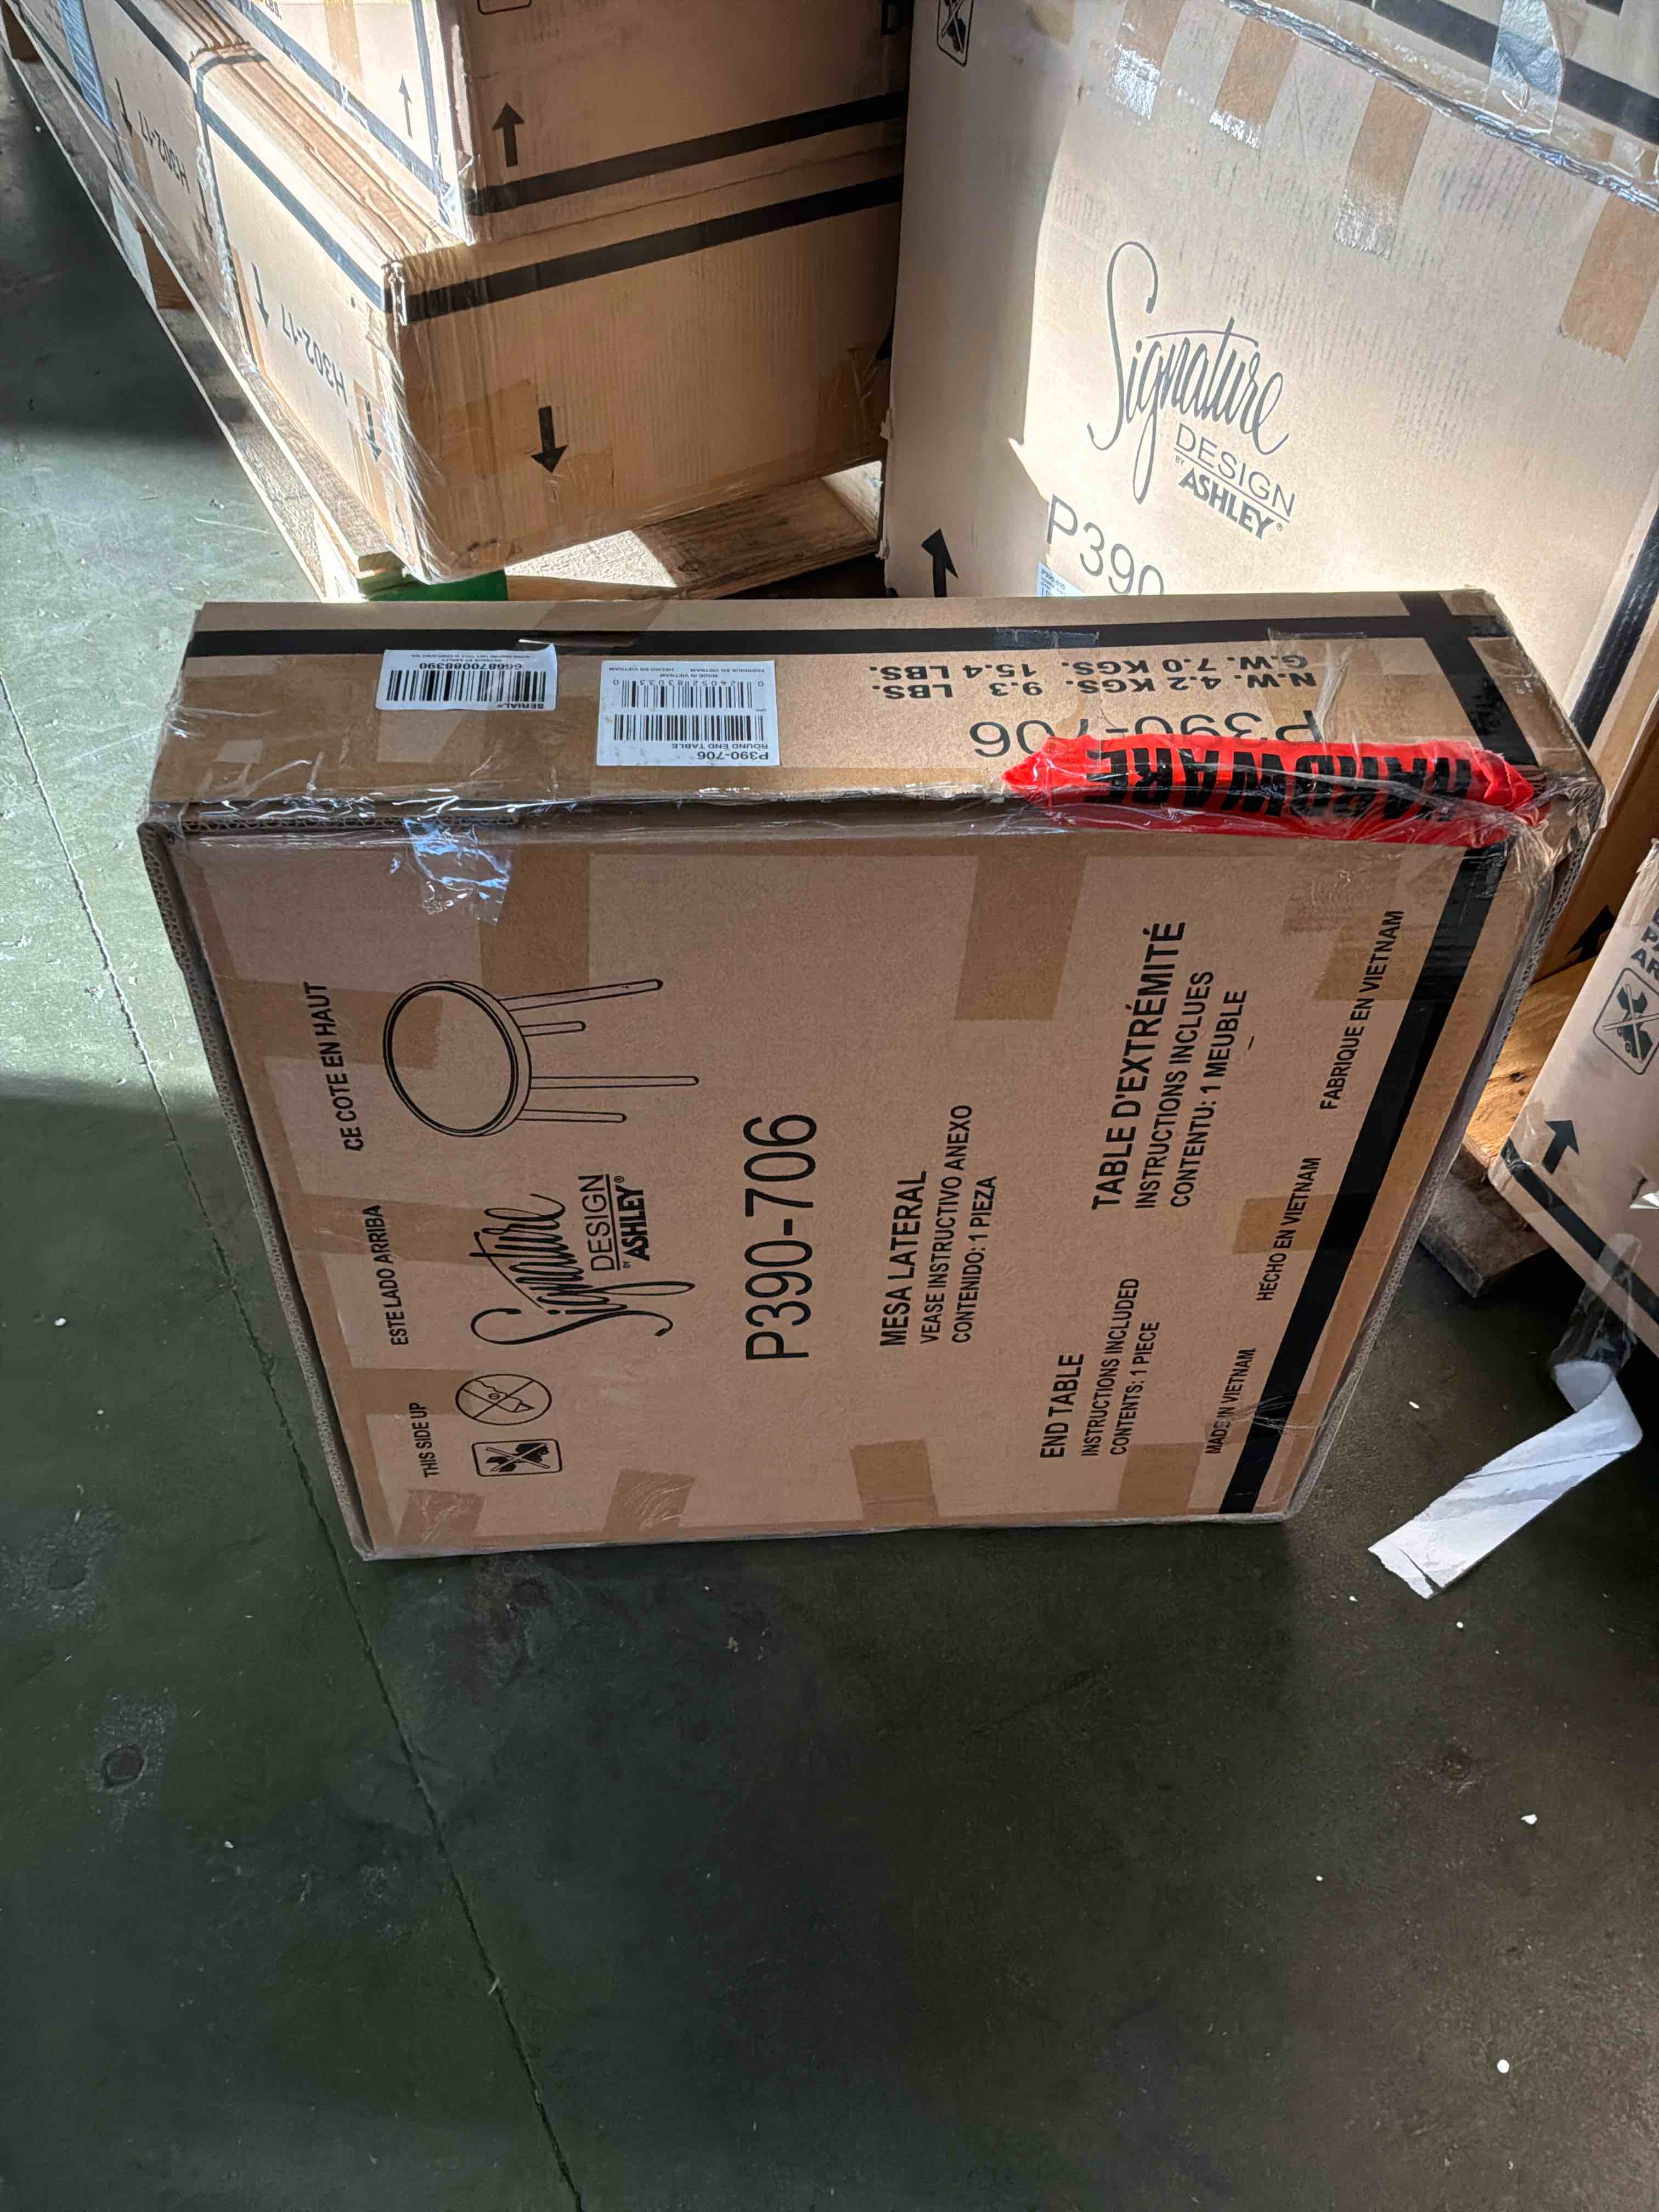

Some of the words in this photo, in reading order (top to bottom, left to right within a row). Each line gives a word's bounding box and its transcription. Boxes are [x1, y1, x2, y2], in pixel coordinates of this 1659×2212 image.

[138, 110, 191, 194] H302-17
[280, 302, 348, 406] H302-17
[1087, 241, 1289, 505] Signature
[1175, 455, 1184, 466] BY
[1176, 423, 1295, 516] DESIGN
[870, 665, 949, 681] LBS.
[963, 664, 1037, 680] 15.4
[1062, 660, 1147, 676] KGS.
[1065, 678, 1154, 694] KGS.
[1161, 658, 1216, 674] 7.0
[1166, 676, 1221, 692] 4.2
[1227, 655, 1307, 671] G.W.
[1233, 673, 1316, 689] N.W.
[872, 683, 952, 699] LBS.
[989, 681, 1042, 697] 9.3
[697, 752, 769, 760] P390-706
[1083, 748, 1472, 822] HARDWARE
[1359, 911, 1404, 992] VIETNAM
[304, 981, 337, 1036] HAUT
[1111, 922, 1185, 1118] D'EXTRÉMITÉ
[1205, 990, 1246, 1076] MEUBLE
[1350, 997, 1375, 1020] EN
[318, 1041, 343, 1067] EN
[1320, 1025, 1364, 1109] FABRIQUE
[329, 1073, 358, 1121] COTE
[1135, 1071, 1188, 1209] INSTRUCTIONS
[1169, 972, 1214, 1064] INCLUES
[1200, 1085, 1221, 1094] 1
[342, 1126, 363, 1151] CE
[943, 1105, 972, 1170] ANEXO
[1171, 1101, 1216, 1207] CONTENTU:
[1092, 1127, 1136, 1210] TABLE
[1280, 1158, 1322, 1225] VIETNAM
[363, 1205, 393, 1264] ARRIBA
[579, 1175, 612, 1271] DESIGN
[743, 1114, 816, 1360] P390-706
[887, 1171, 927, 1279] LATERAL
[927, 1177, 963, 1288] INSTRUCTIVO
[1273, 1229, 1296, 1249] EN
[469, 1194, 695, 1345] Signature
[951, 1248, 985, 1343] CONTENIDO:
[969, 1176, 997, 1227] PIEZA
[376, 1269, 402, 1308] LADO
[387, 1311, 409, 1345] ESTE
[879, 1286, 913, 1346] MESA
[920, 1294, 945, 1343] VEASE
[1048, 1353, 1084, 1417] TABLE
[1081, 1359, 1120, 1456] INSTRUCTIONS
[1104, 1278, 1139, 1354] INCLUDED
[1110, 1380, 1146, 1455] CONTENTS:
[1133, 1322, 1159, 1364] PIECE
[410, 1403, 431, 1419] UP
[414, 1420, 436, 1449] SIDE
[1216, 1407, 1235, 1418] IN
[1040, 1423, 1069, 1458] END
[1205, 1421, 1231, 1454] MADE
[420, 1451, 440, 1477] THIS
